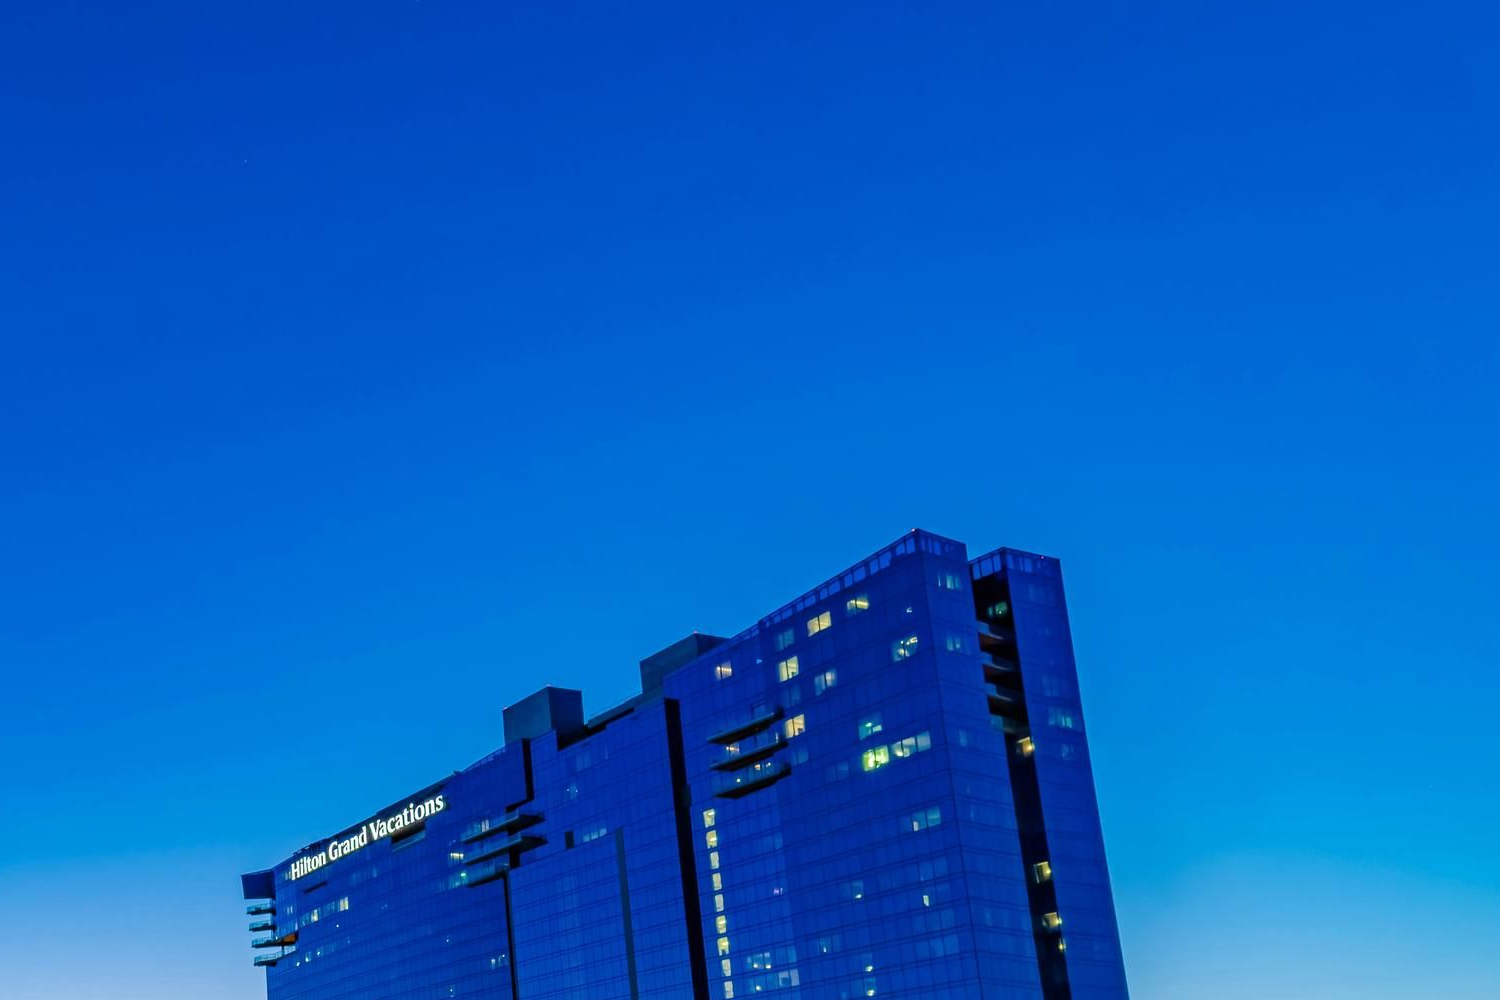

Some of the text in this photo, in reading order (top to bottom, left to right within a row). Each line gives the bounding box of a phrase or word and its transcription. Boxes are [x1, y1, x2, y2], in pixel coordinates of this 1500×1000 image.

[291, 795, 444, 880] Hilton Grand Vacations
